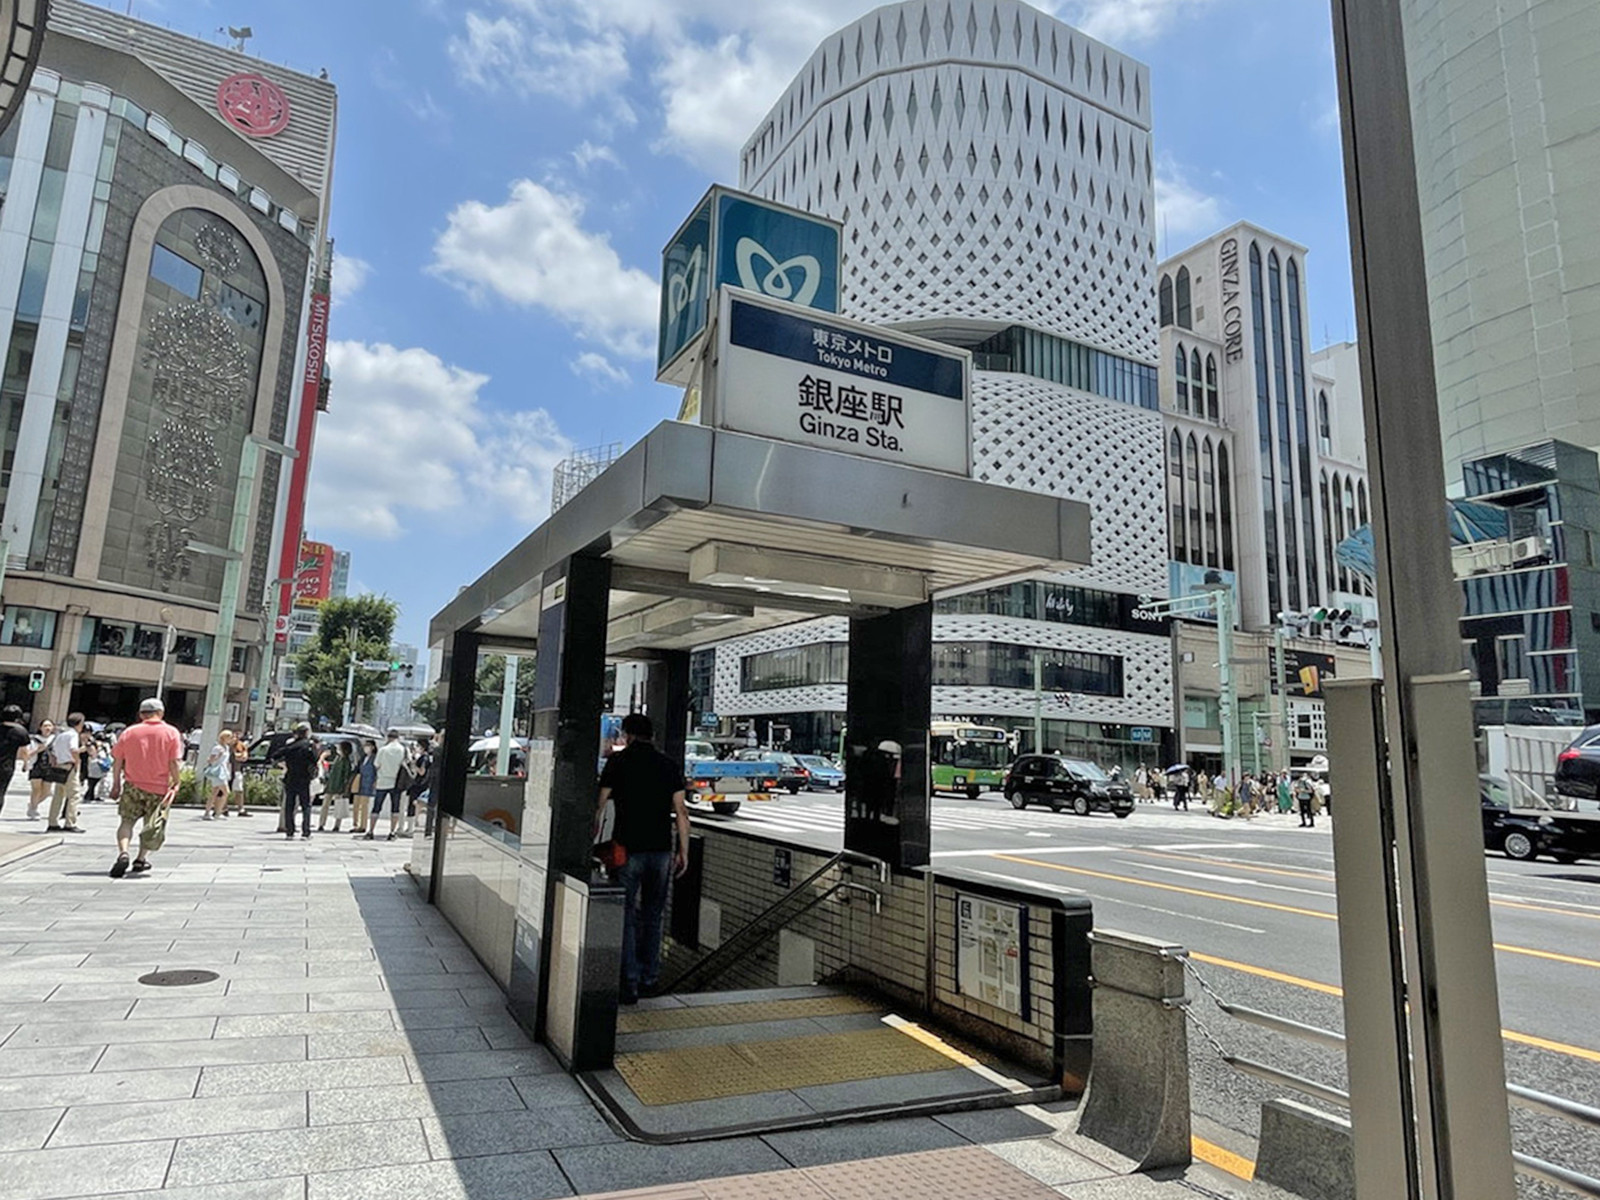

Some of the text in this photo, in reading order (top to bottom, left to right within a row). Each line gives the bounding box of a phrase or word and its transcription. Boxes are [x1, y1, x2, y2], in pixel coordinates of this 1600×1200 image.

[1221, 238, 1243, 364] GINZA CORE
[306, 299, 326, 383] MITSUKOSHI
[812, 328, 892, 364] 東京メトロ
[817, 348, 887, 377] Tokyo Metro
[798, 374, 904, 429] 銀座駅
[799, 413, 903, 452] Ginza Sta.
